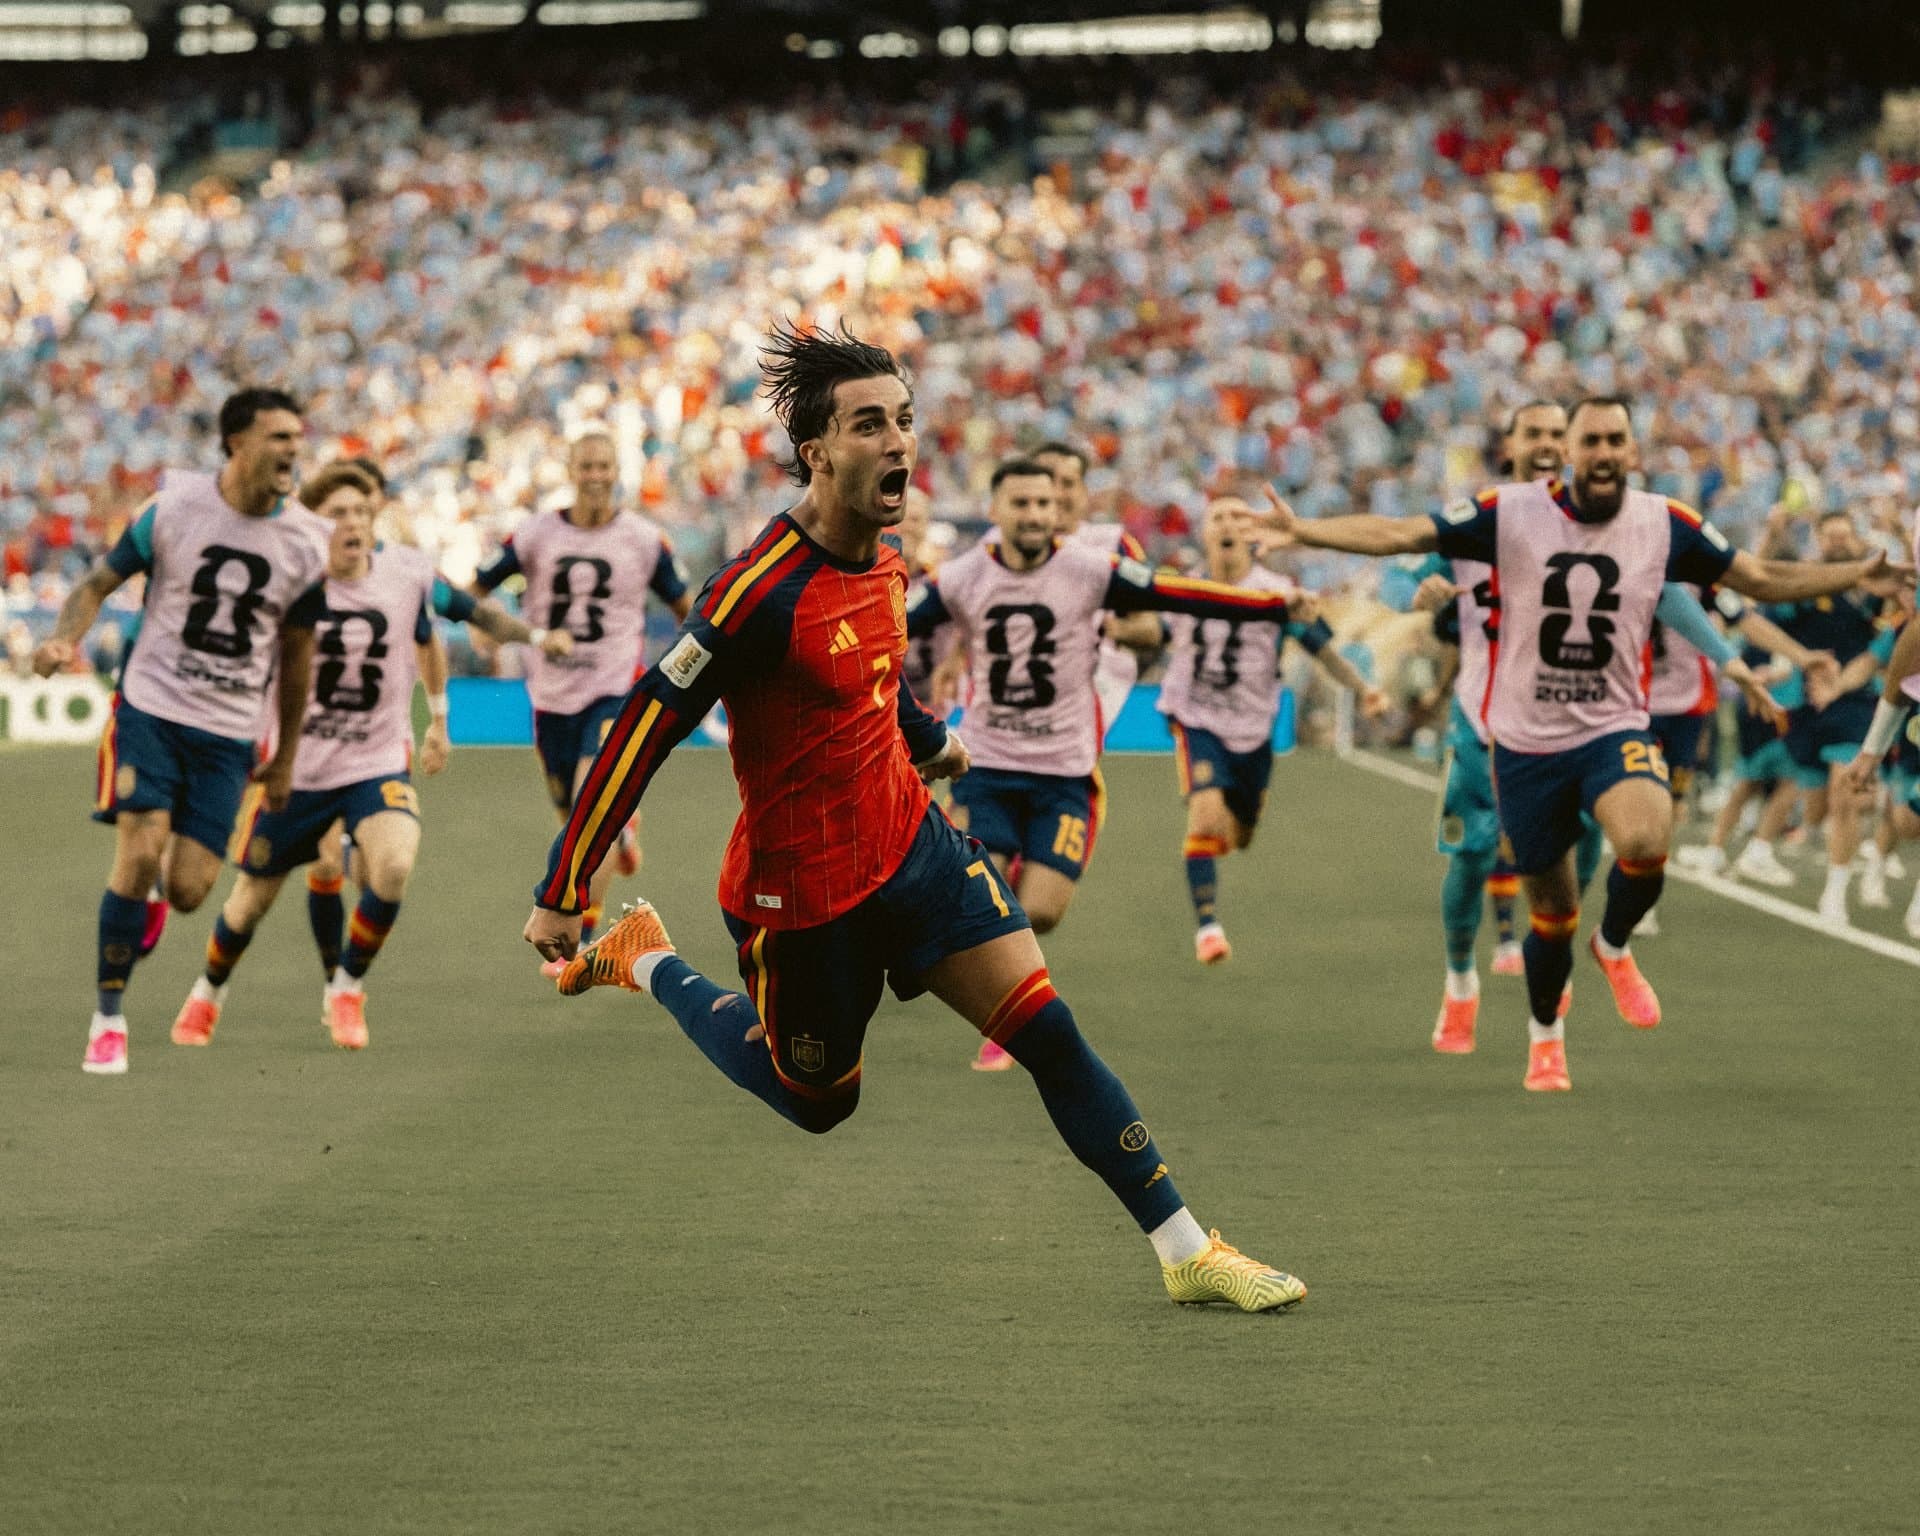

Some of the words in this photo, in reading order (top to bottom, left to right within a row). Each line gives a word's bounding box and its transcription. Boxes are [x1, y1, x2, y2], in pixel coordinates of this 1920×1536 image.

[873, 653, 891, 708] 7
[1052, 813, 1086, 863] 15
[966, 859, 1010, 917] 7
